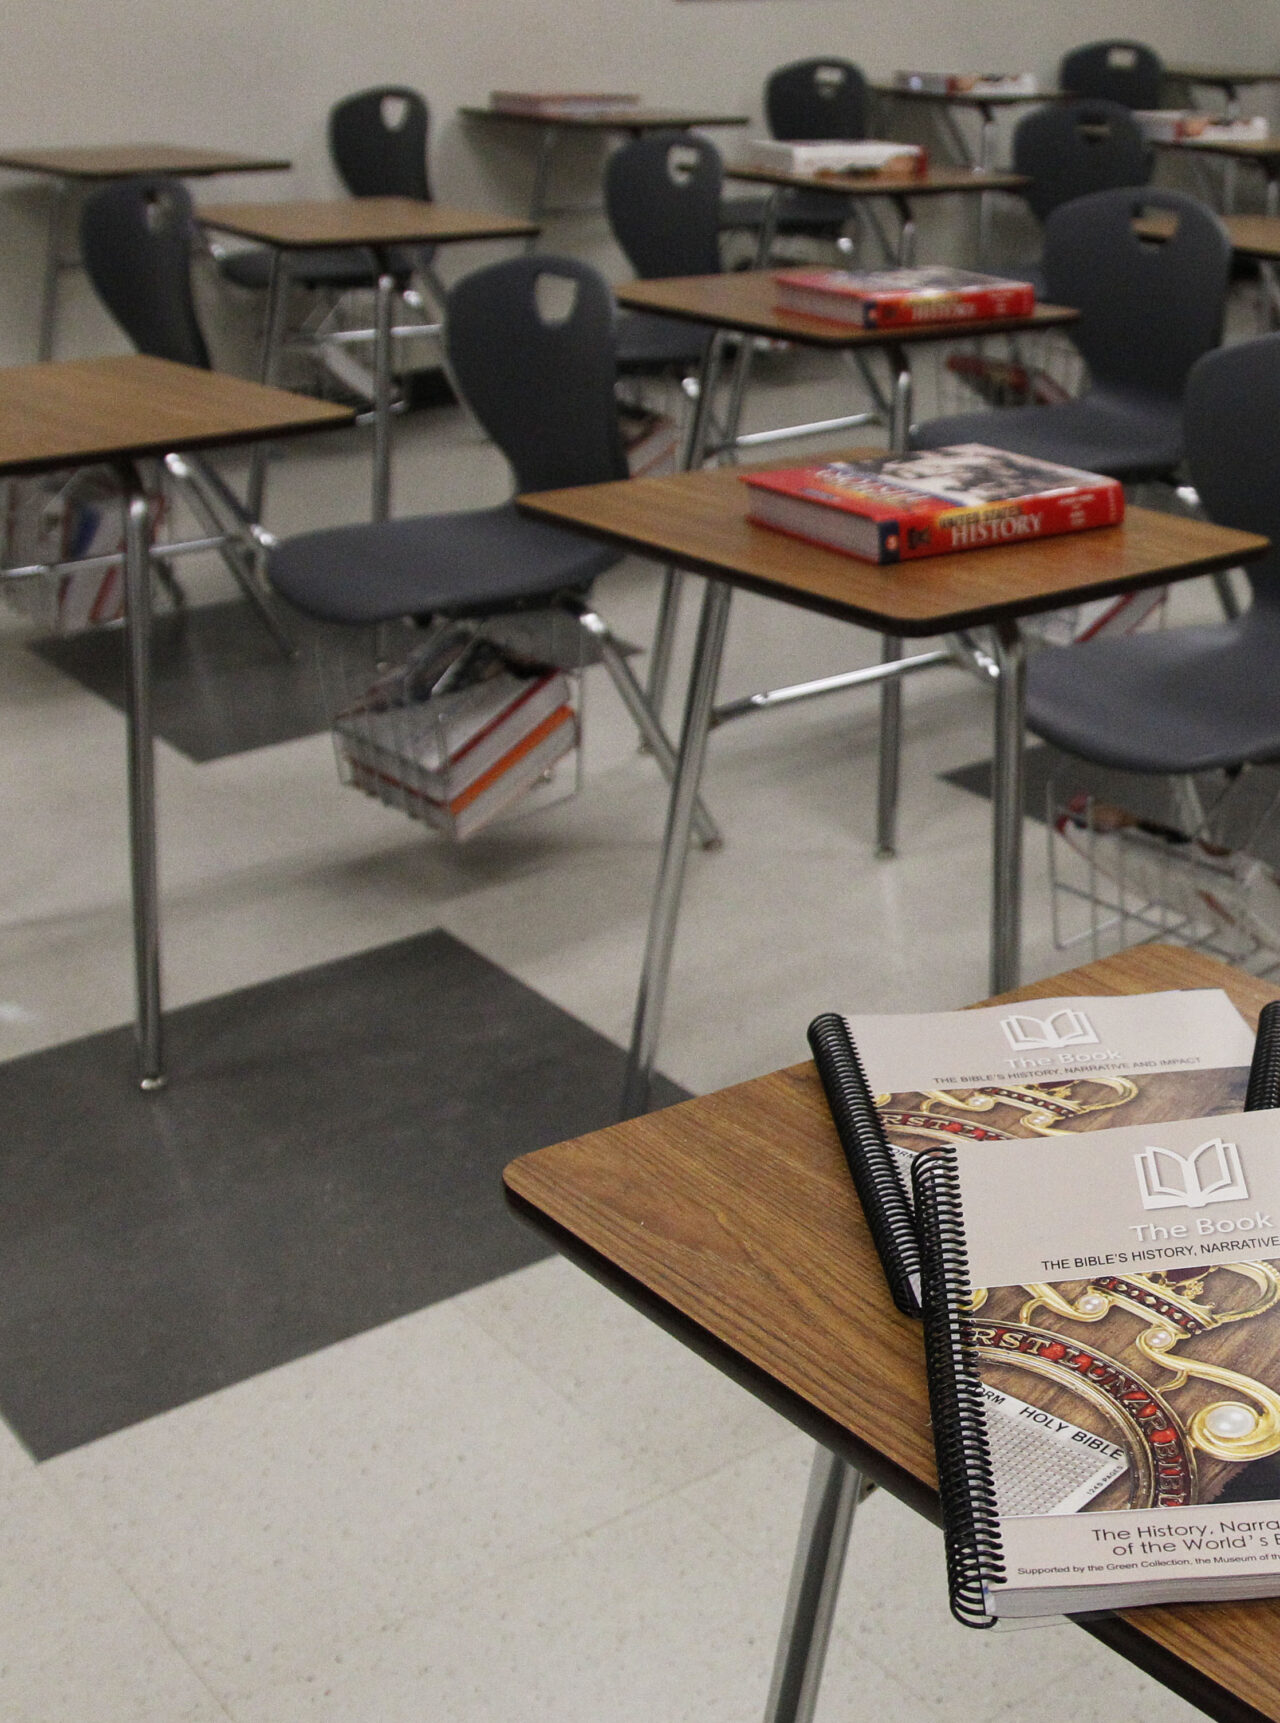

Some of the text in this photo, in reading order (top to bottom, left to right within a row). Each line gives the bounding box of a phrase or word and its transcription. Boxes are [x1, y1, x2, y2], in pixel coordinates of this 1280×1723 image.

[952, 511, 1043, 547] HISTORY
[934, 1056, 1201, 1085] THE BIBLE'S HISTORY, NARRATIVE AND IMPACT
[1004, 1050, 1123, 1070] The Book
[1129, 1212, 1274, 1242] The Book
[1042, 1258, 1071, 1271] THE
[1074, 1253, 1128, 1268] BIBLE'S
[1132, 1245, 1198, 1262] HISTORY,
[1201, 1236, 1280, 1254] NARRATIVE
[971, 1327, 1051, 1355] RST
[1019, 1406, 1070, 1433] HOLY
[1071, 1431, 1125, 1461] BIBLE
[1091, 1528, 1131, 1542] The
[1112, 1542, 1135, 1556] of
[1140, 1541, 1177, 1555] the
[1017, 1565, 1070, 1576] Supported
[1072, 1564, 1085, 1574] by
[1087, 1564, 1104, 1572] the
[1106, 1561, 1138, 1571] Green
[1141, 1558, 1194, 1568] Collection,
[1195, 1557, 1212, 1565] the
[1213, 1555, 1257, 1564] Museum
